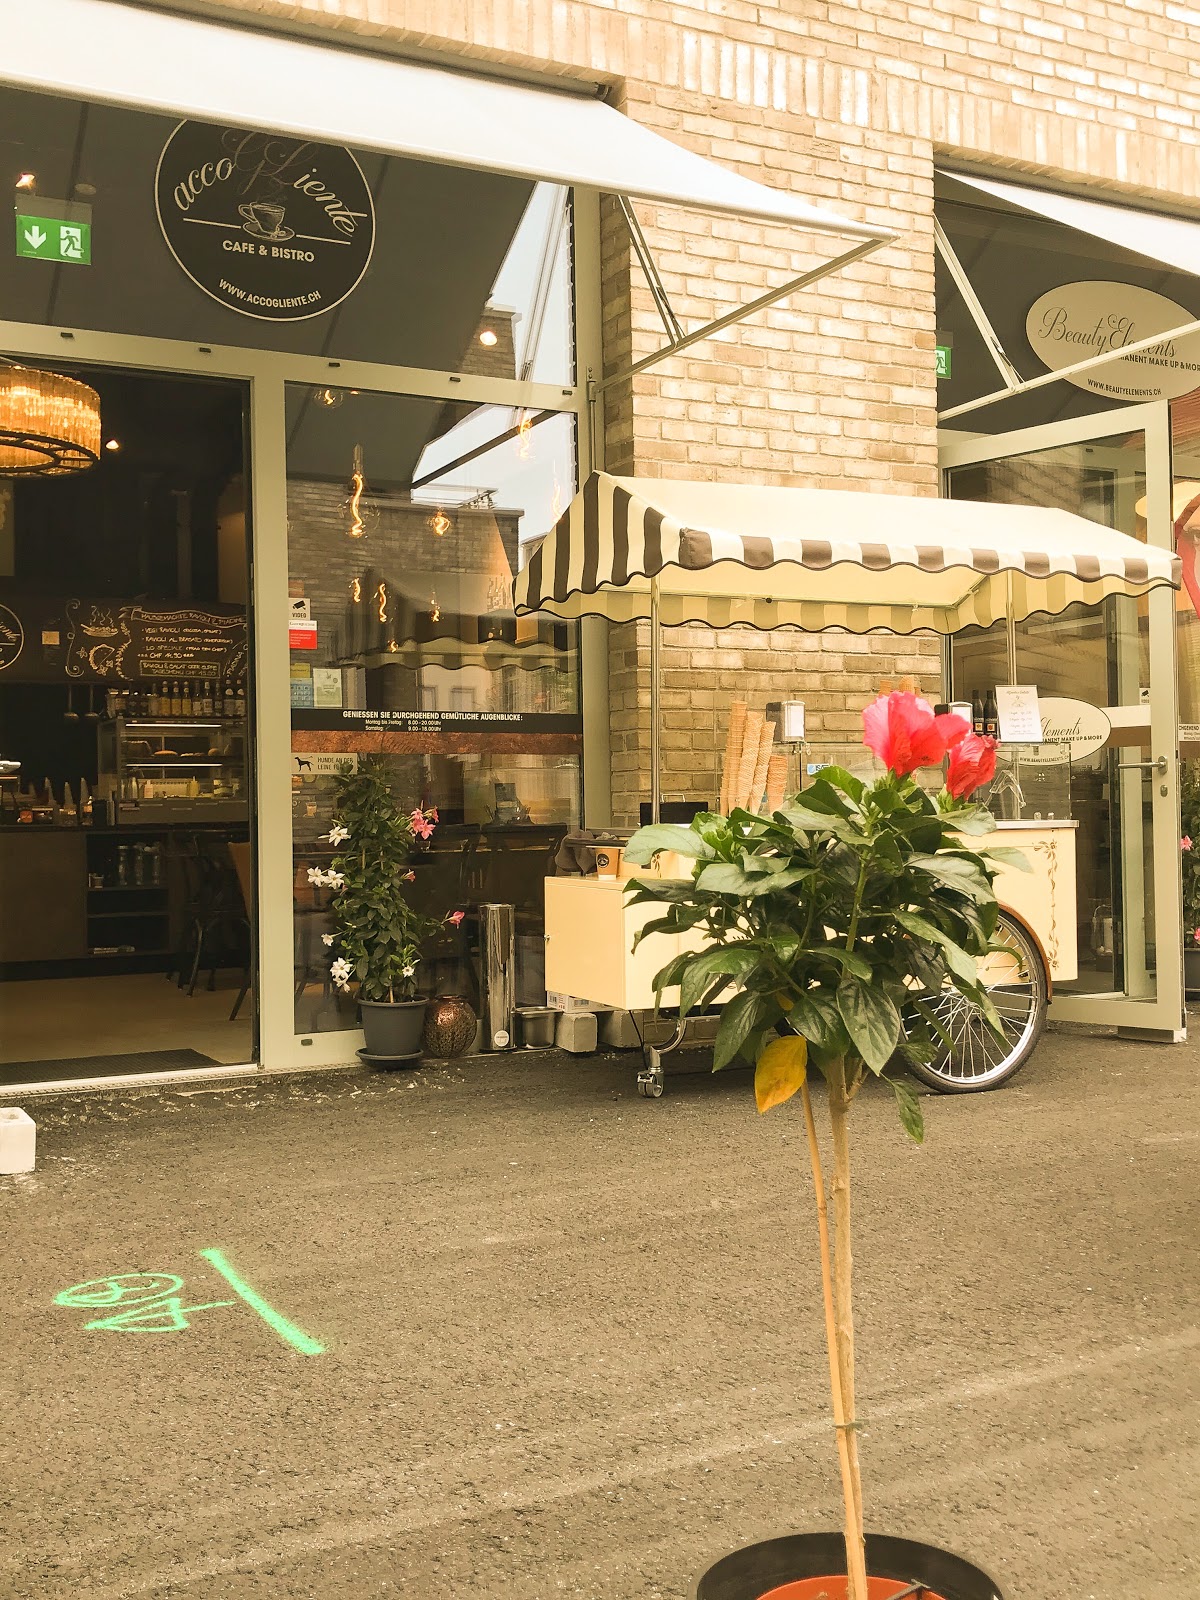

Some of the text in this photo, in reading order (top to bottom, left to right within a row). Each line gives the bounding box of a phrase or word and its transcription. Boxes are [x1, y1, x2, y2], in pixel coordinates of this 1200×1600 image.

[222, 239, 315, 262] CAFE & BISTRO
[218, 278, 322, 308] WWW.ACCOGLIENTE.CH
[1149, 357, 1169, 368] MAKE
[1170, 360, 1179, 369] UP
[1185, 363, 1200, 372] MOR
[1087, 378, 1162, 396] WWW.BEAUTYELEMENTS.CH
[343, 710, 523, 721] GENIESSEN SIE DURCHGEHEND GEMÜTLICHE AUGENBLICKE:
